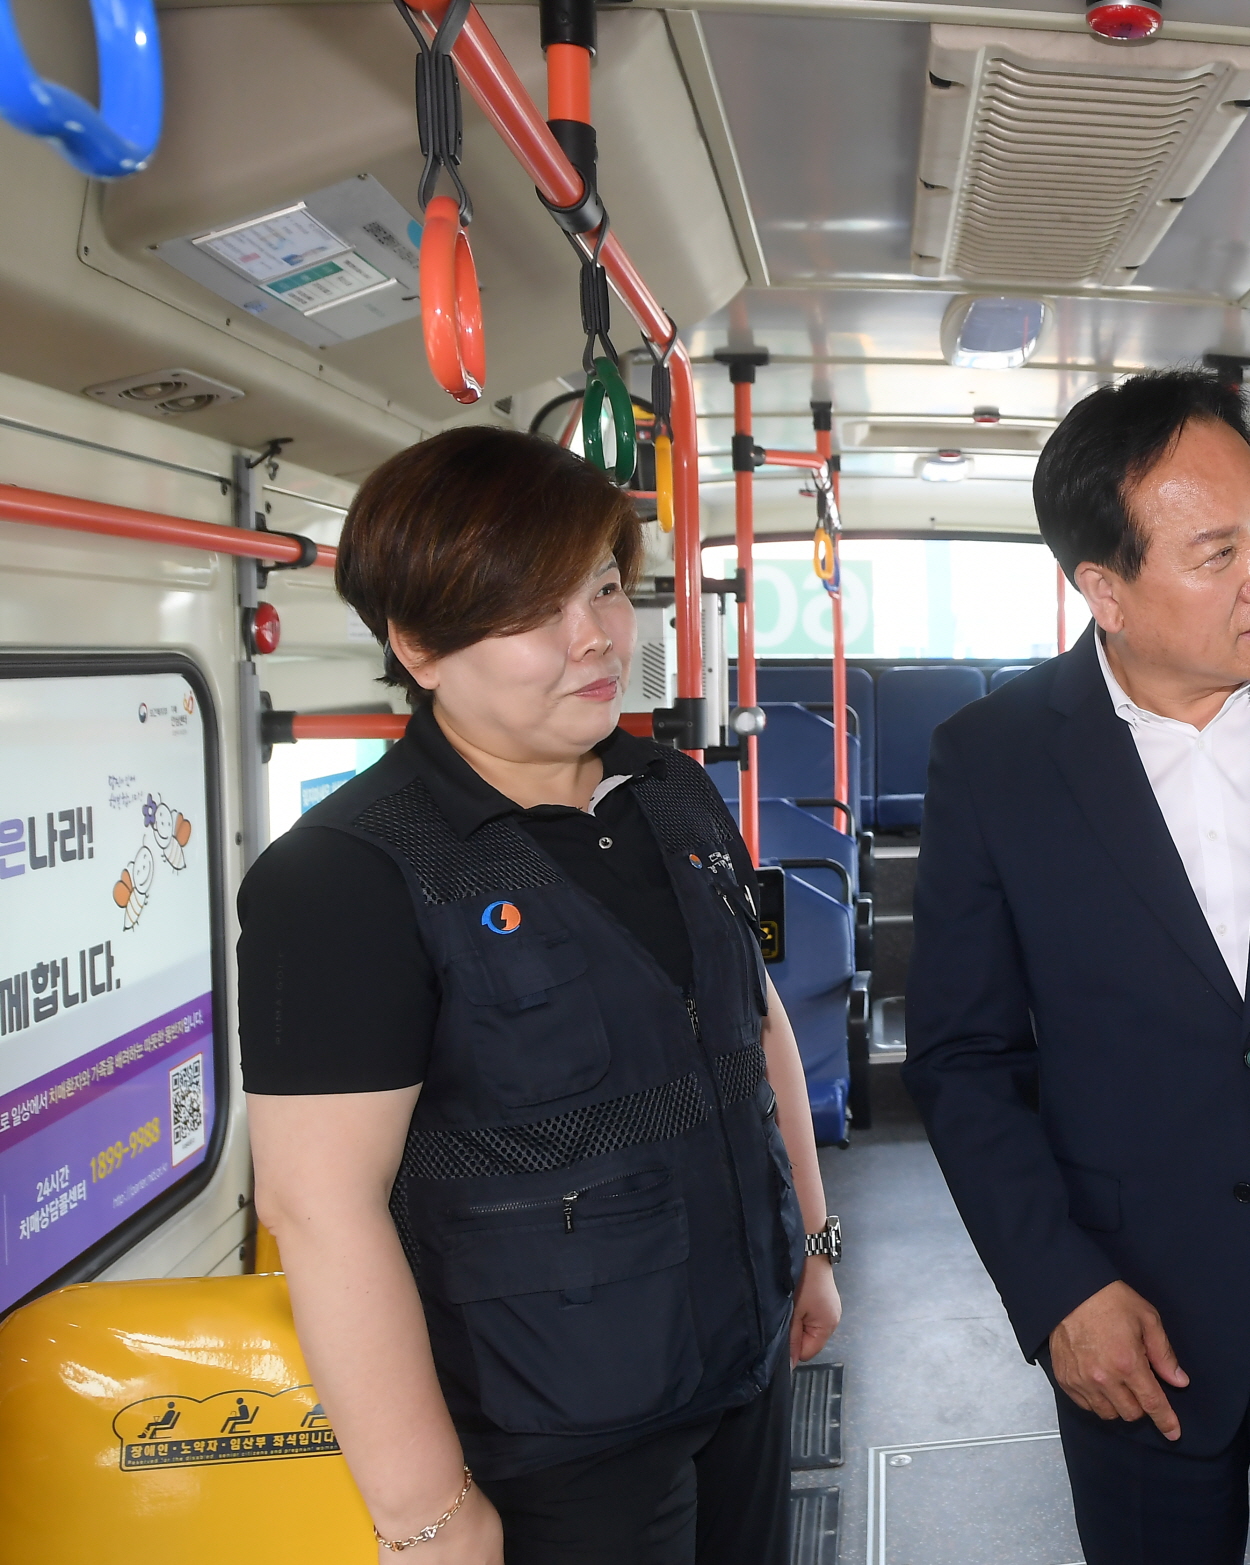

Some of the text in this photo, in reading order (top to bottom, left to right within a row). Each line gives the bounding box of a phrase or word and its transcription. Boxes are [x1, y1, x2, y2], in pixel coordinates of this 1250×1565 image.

[11, 1091, 48, 1126] 일상에서
[49, 1068, 91, 1104] 치매환자와
[91, 1055, 115, 1082] 가족을
[115, 1042, 144, 1069] 배려하는
[90, 1117, 161, 1184] 1899-9988
[19, 1179, 87, 1240] 치매상담콜센터
[36, 1164, 70, 1203] 24시간
